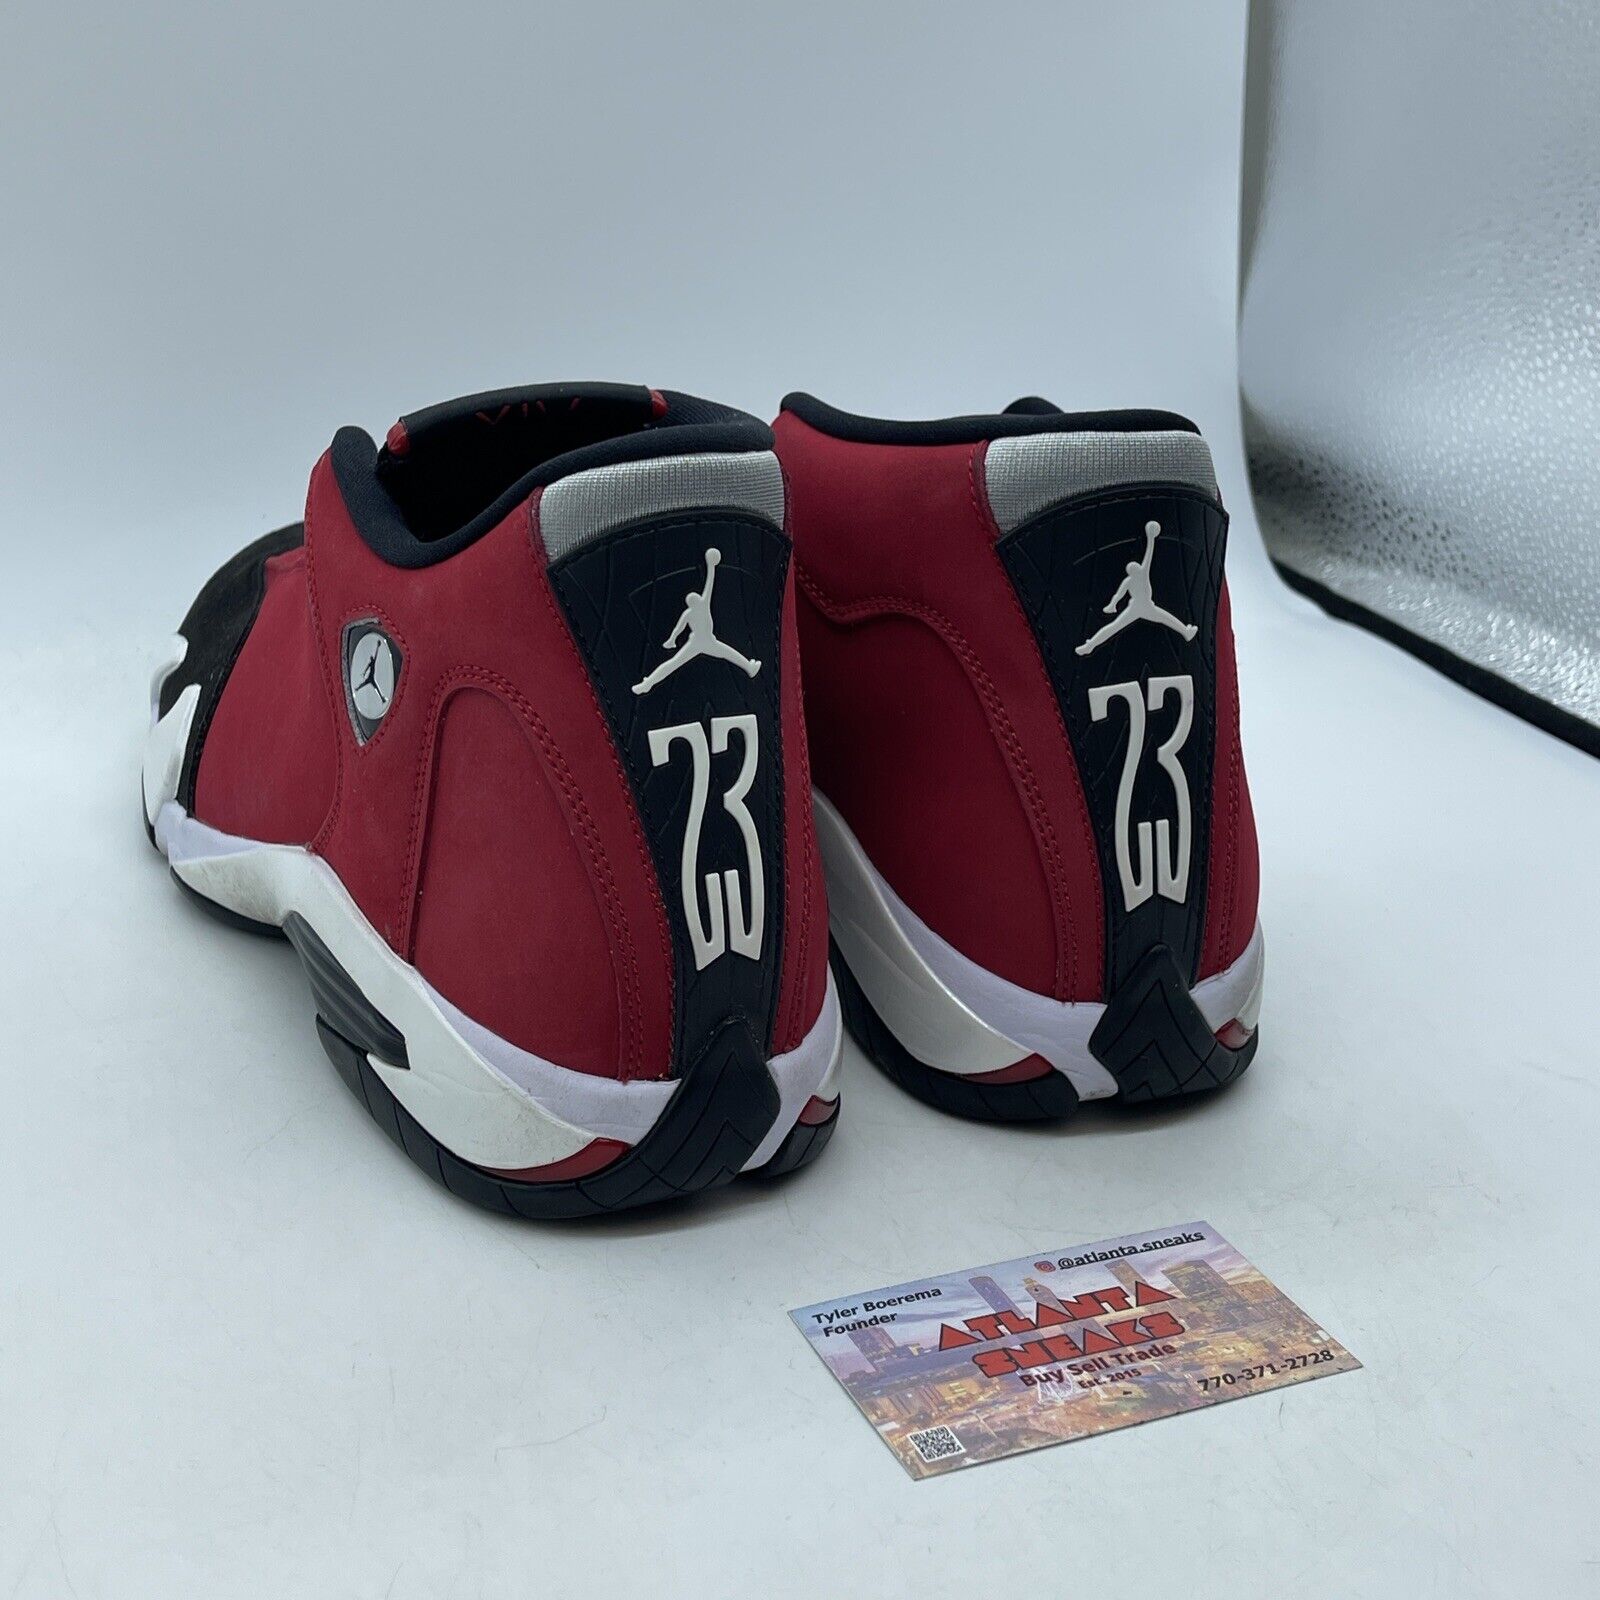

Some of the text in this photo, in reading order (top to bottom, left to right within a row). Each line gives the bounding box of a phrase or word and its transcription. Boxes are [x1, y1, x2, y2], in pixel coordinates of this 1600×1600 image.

[1088, 675, 1195, 913] 23
[648, 714, 765, 971] 23
[1057, 1231, 1206, 1270] @atlanta.sneaks
[812, 1287, 942, 1324] Tyler Boerema
[823, 1312, 898, 1337] Founder
[939, 1281, 1177, 1351] ATLANTA
[972, 1311, 1186, 1378] SNEAKS
[1020, 1342, 1178, 1387] Buy Sell Trade
[1078, 1368, 1142, 1389] Est. 2015
[1197, 1349, 1335, 1392] 770-371-2728
